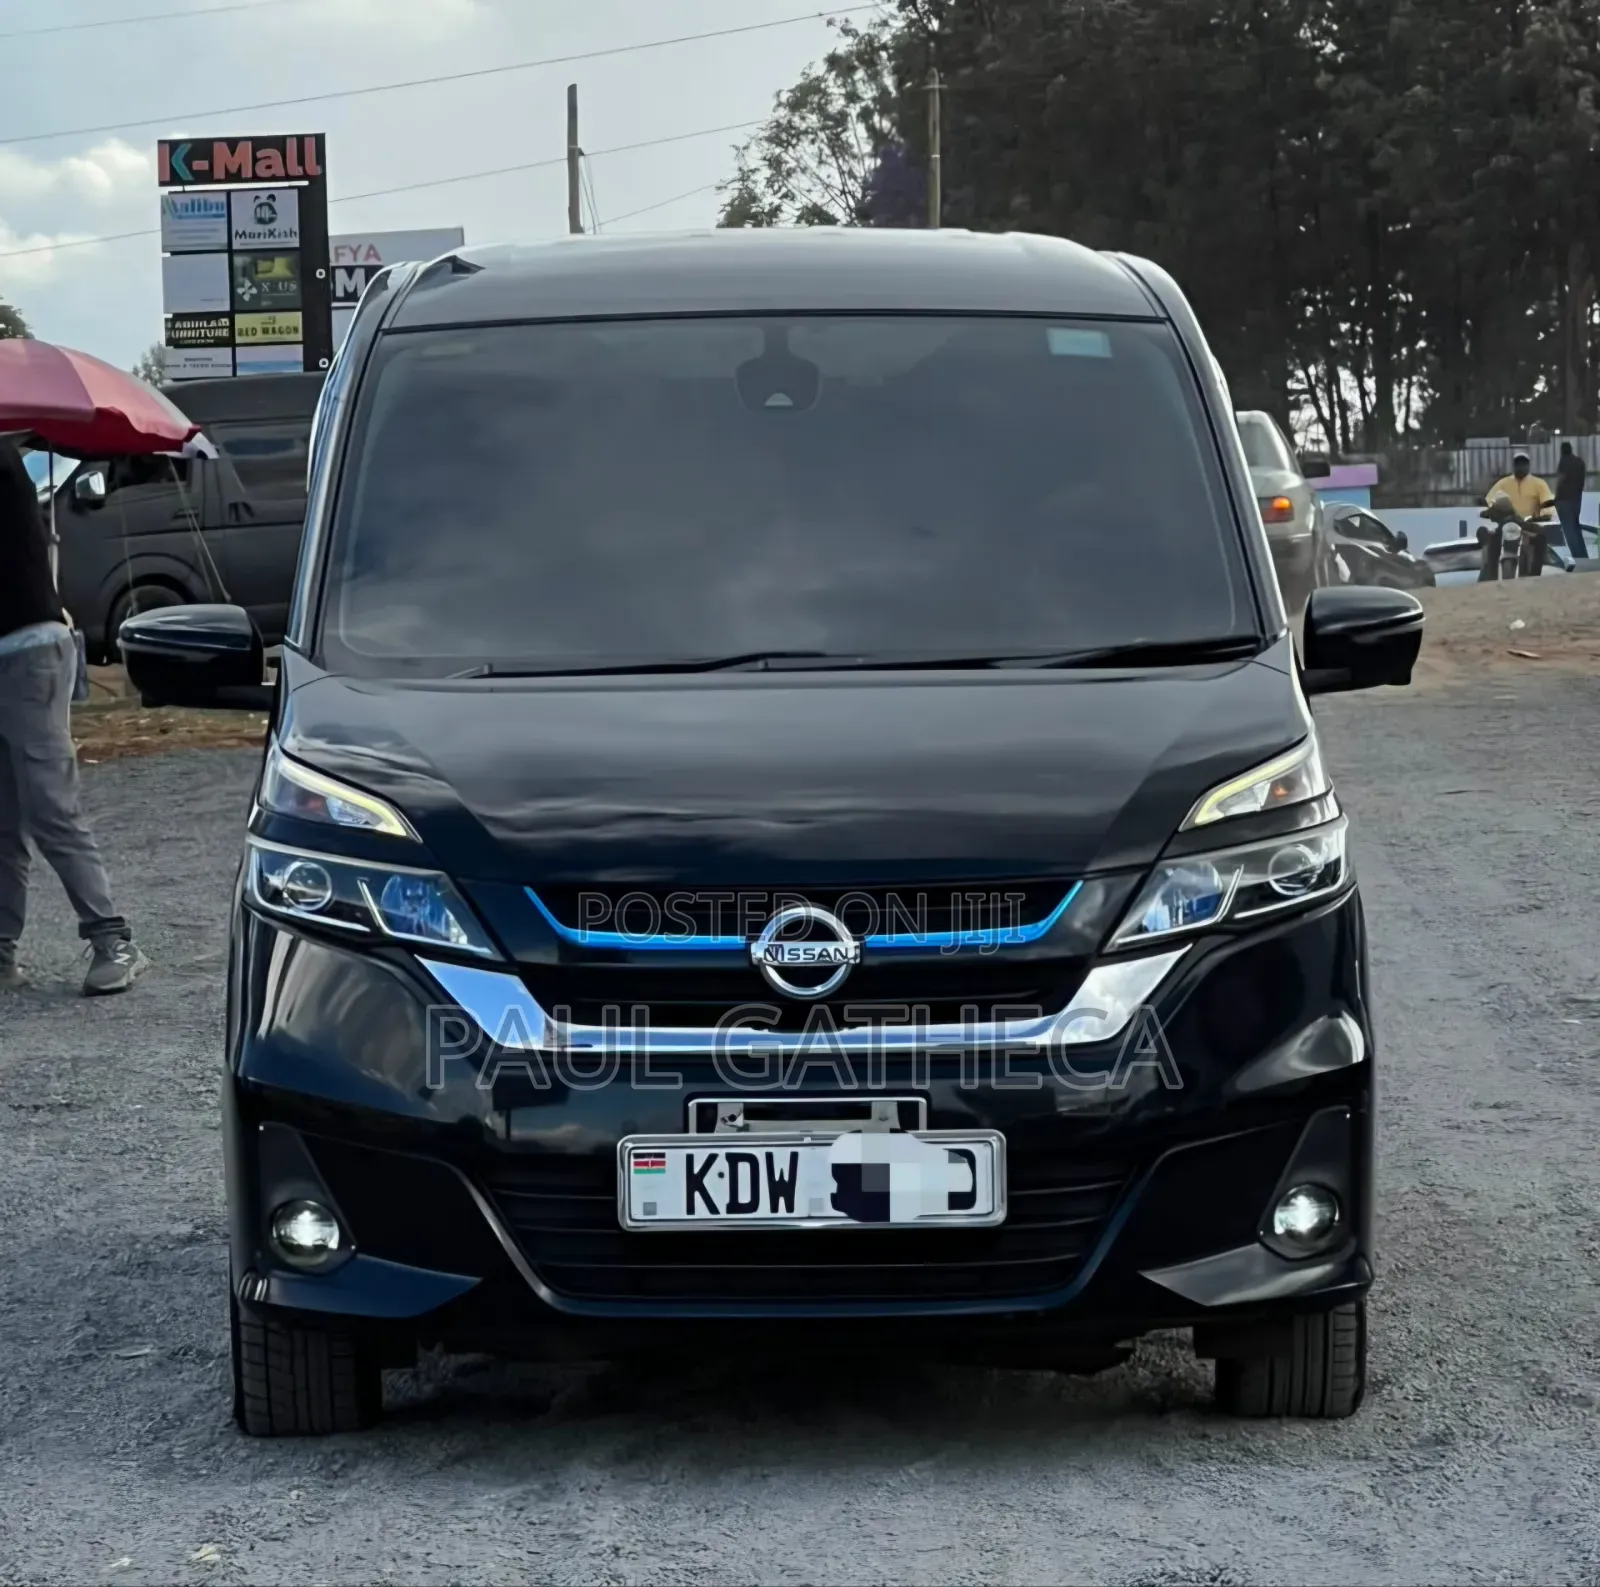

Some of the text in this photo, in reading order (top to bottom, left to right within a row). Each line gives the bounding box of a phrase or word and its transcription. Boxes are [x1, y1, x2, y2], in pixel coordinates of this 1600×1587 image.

[158, 136, 323, 182] K-Mall
[331, 243, 382, 263] FYA
[763, 944, 848, 962] NISSAN
[685, 1150, 799, 1215] KDW
